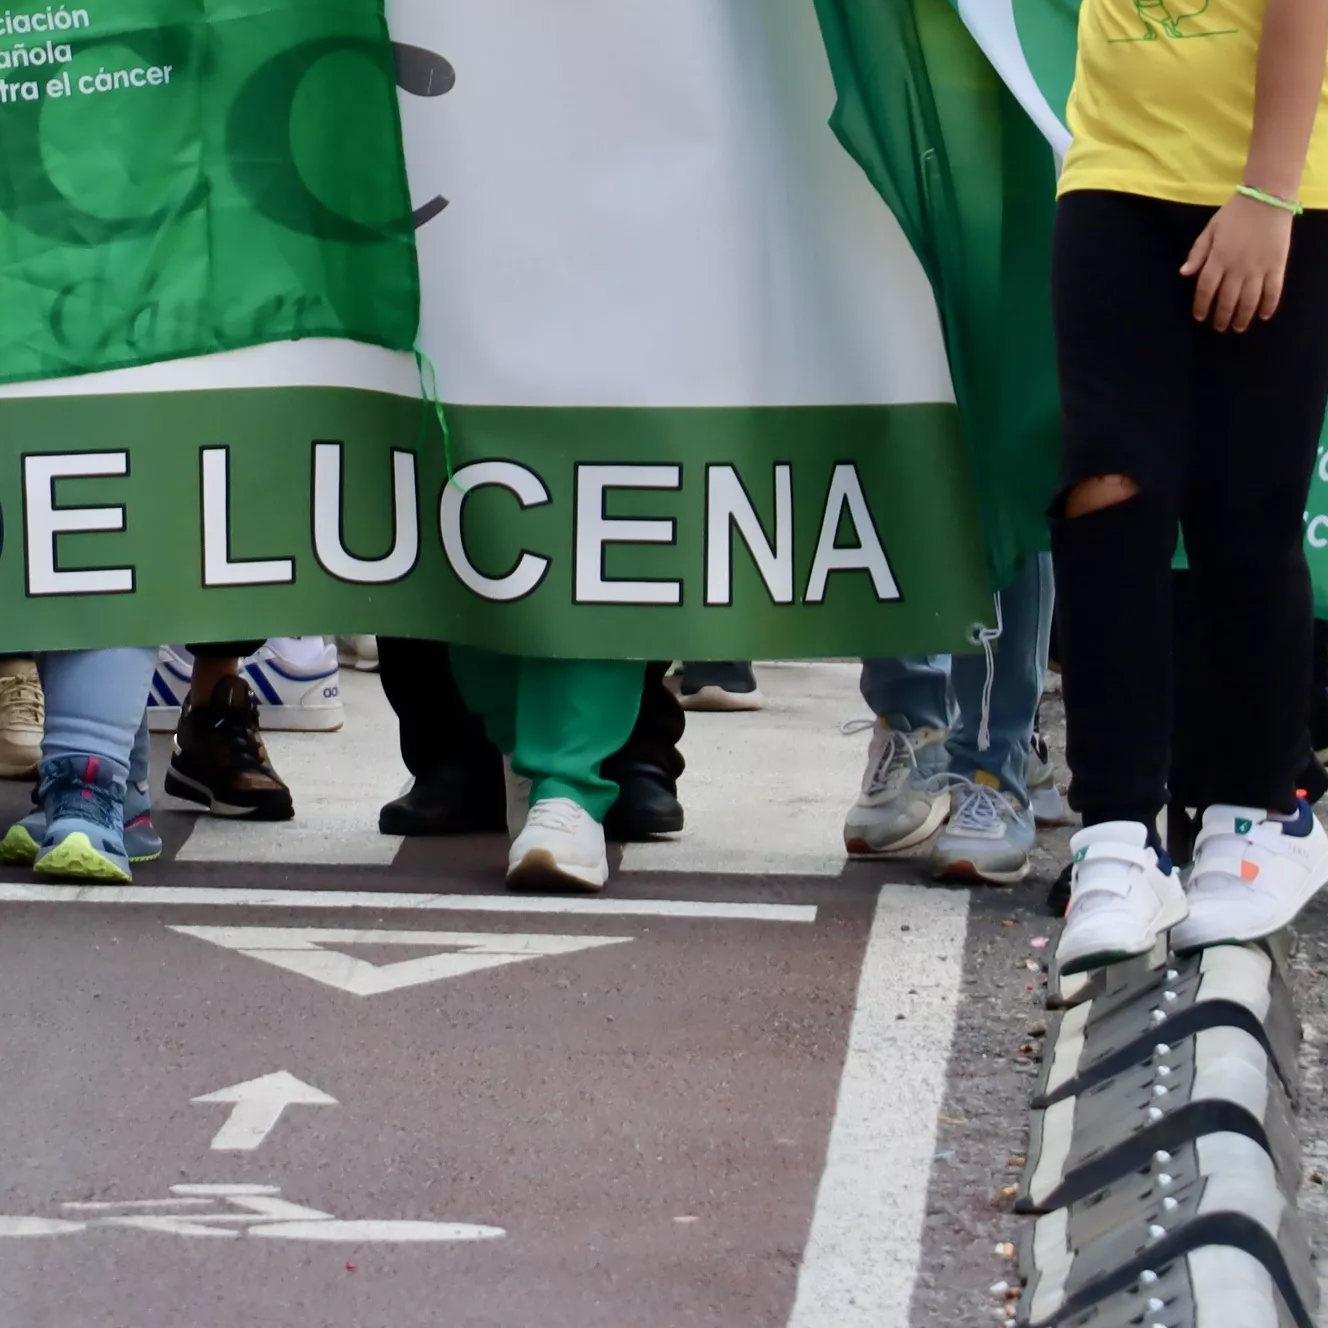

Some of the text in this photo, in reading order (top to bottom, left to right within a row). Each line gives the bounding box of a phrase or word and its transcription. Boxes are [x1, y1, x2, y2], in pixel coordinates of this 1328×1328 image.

[46, 72, 72, 97] el
[77, 64, 174, 94] cáncer
[198, 438, 904, 607] LUCENA
